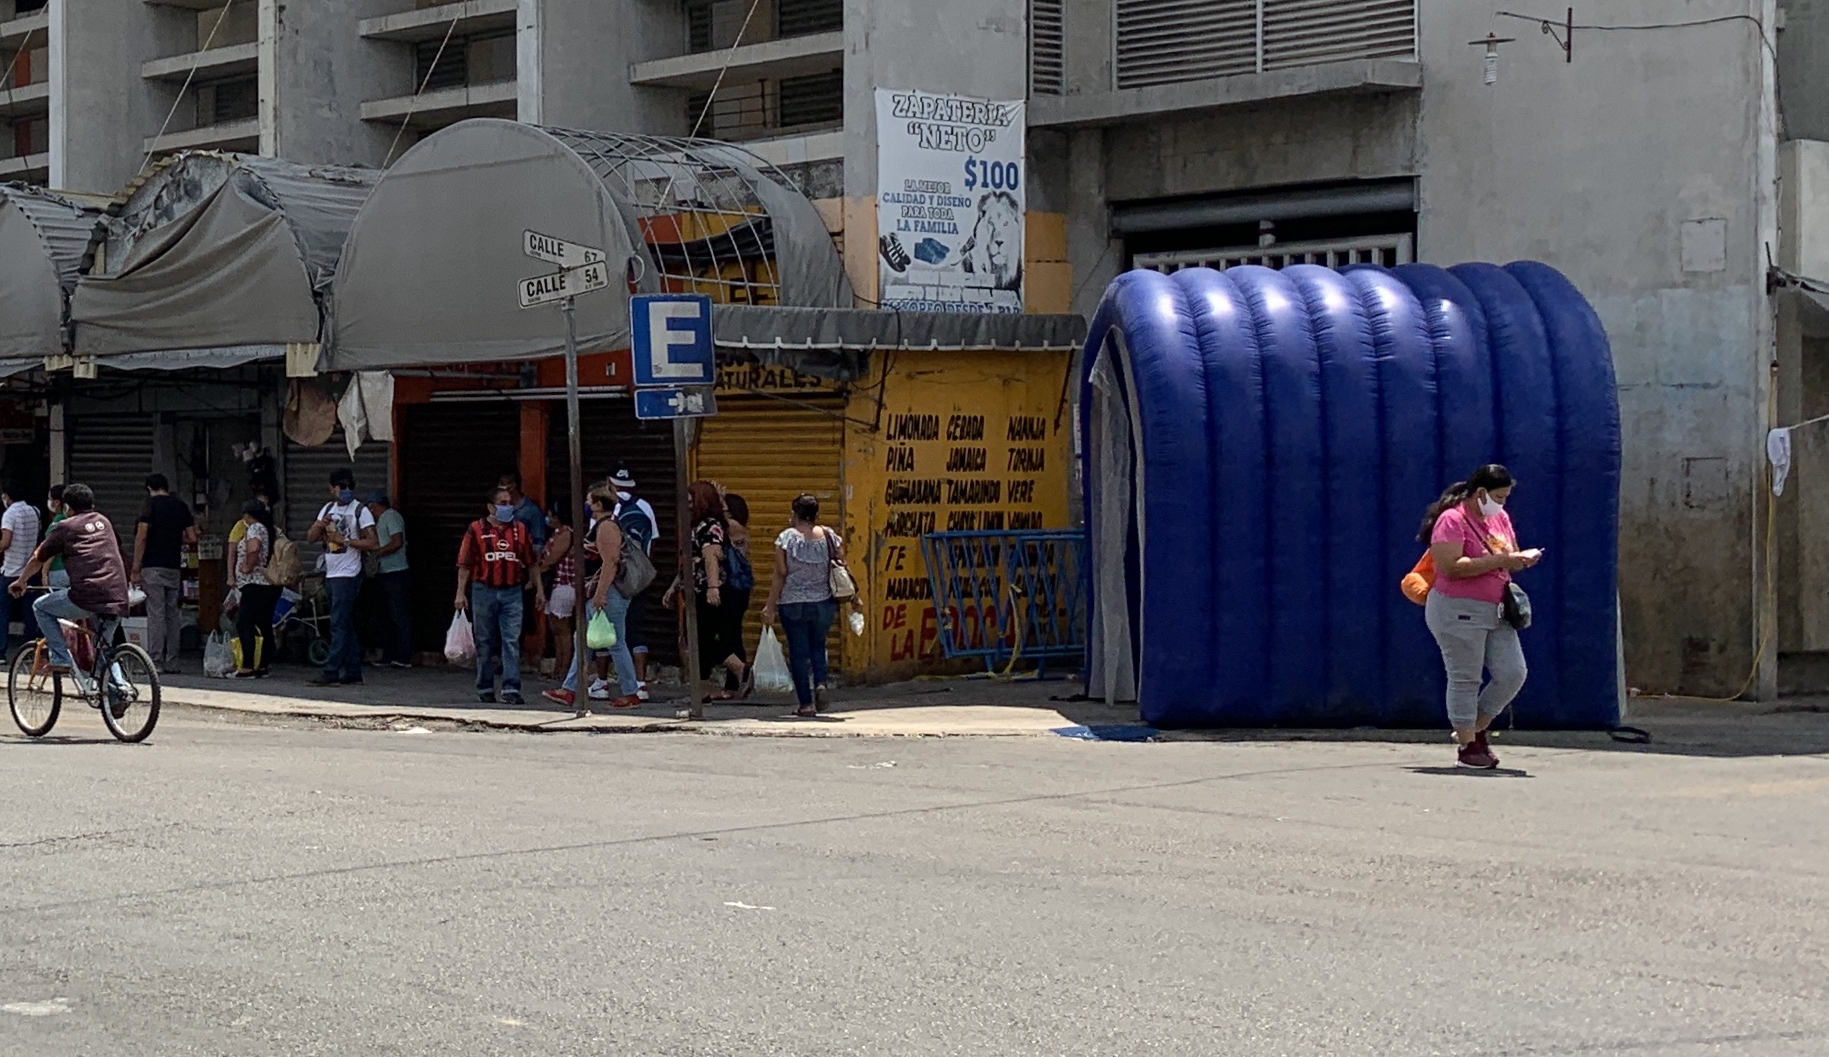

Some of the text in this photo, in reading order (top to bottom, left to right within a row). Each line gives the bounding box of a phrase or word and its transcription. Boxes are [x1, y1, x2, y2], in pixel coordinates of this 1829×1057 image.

[893, 94, 1010, 127] ZAPATERIA
[964, 155, 1019, 191] $100
[904, 179, 951, 194] LA MEJOR
[883, 192, 972, 208] CALIDAD Y DISEÑO
[901, 206, 954, 220] PARA TODA
[897, 219, 959, 235] LA FAMILIA
[529, 234, 598, 263] CALLE 67
[527, 274, 566, 297] CALLE
[585, 267, 599, 284] 54
[649, 301, 704, 378] E
[713, 369, 821, 391] ATURALES
[886, 414, 939, 440] LIMONADA
[947, 415, 985, 440] CEBADA
[886, 442, 914, 472] PIÑA
[947, 448, 986, 472] JAMAICA
[947, 479, 1001, 504] TAMARINDO
[485, 551, 519, 562] OPEL
[885, 546, 906, 571] TE
[883, 604, 907, 631] DE
[891, 630, 914, 661] LA
